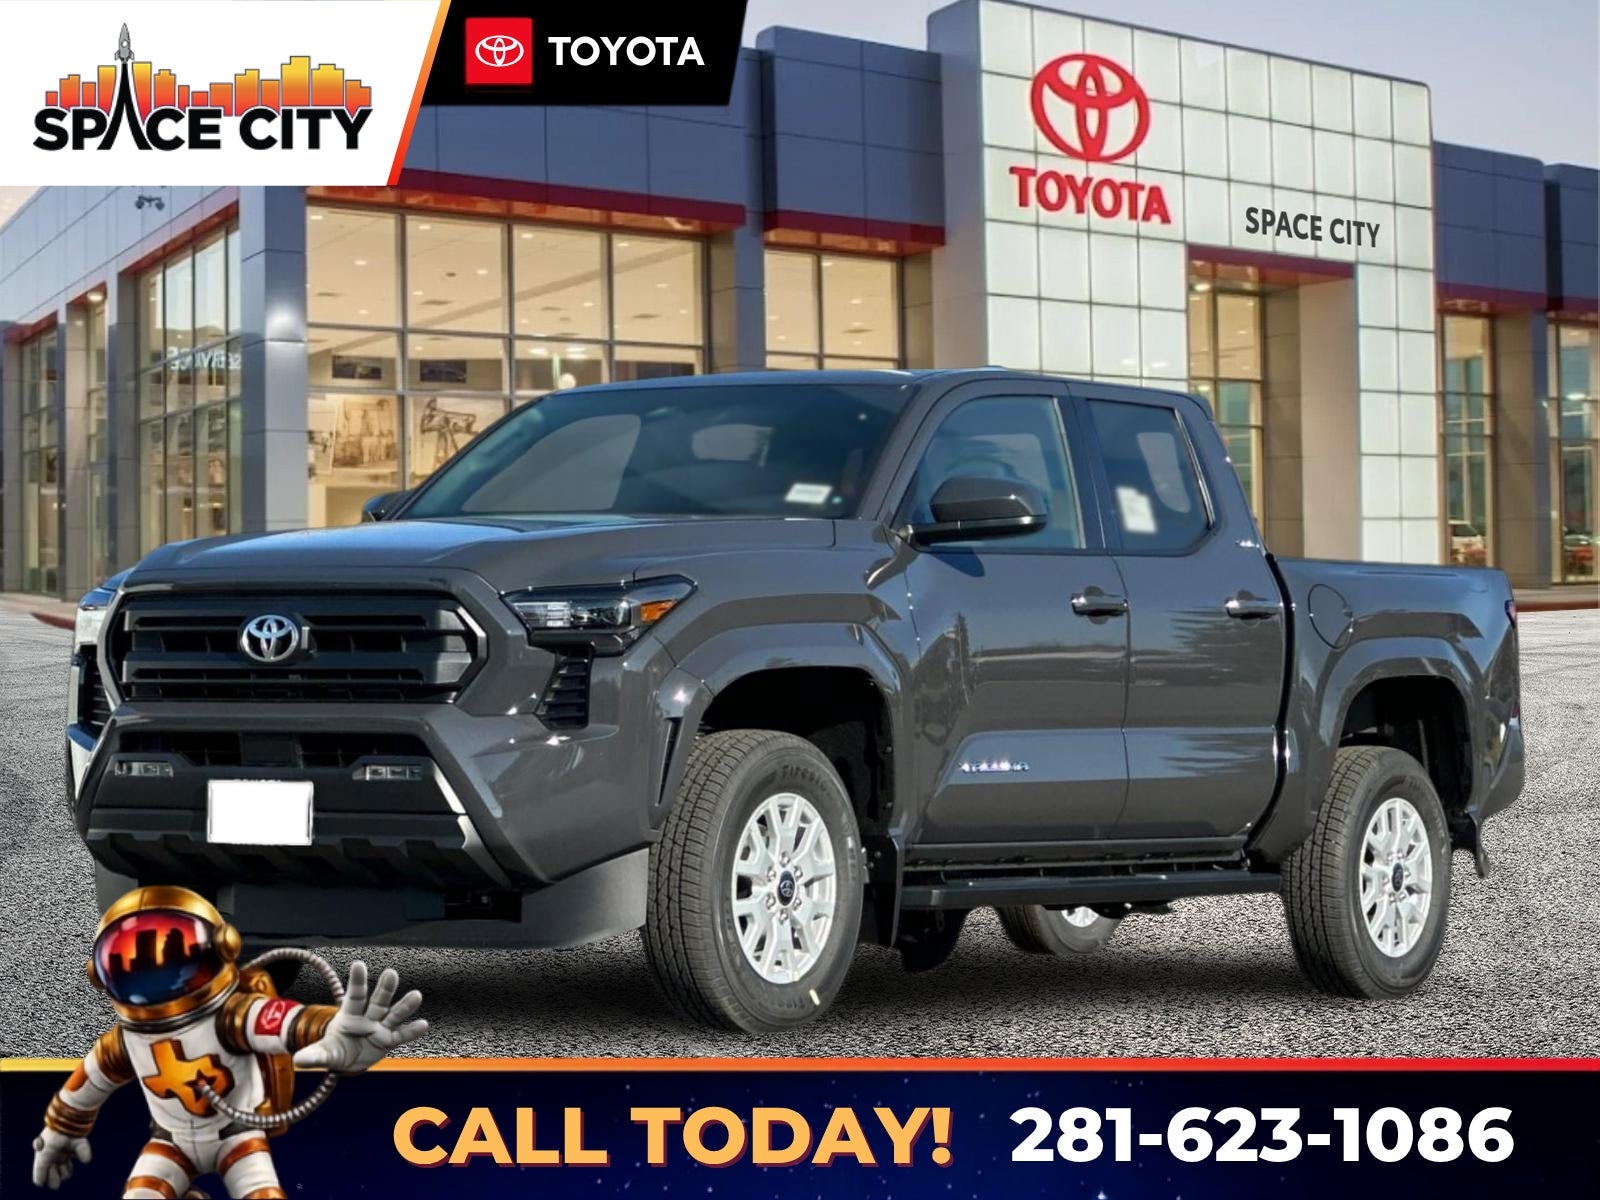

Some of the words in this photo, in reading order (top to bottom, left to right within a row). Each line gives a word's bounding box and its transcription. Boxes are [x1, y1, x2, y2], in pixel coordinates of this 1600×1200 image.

[1009, 165, 1171, 225] TOYOTA
[1245, 206, 1322, 242] SPACE
[1329, 218, 1381, 248] CITY
